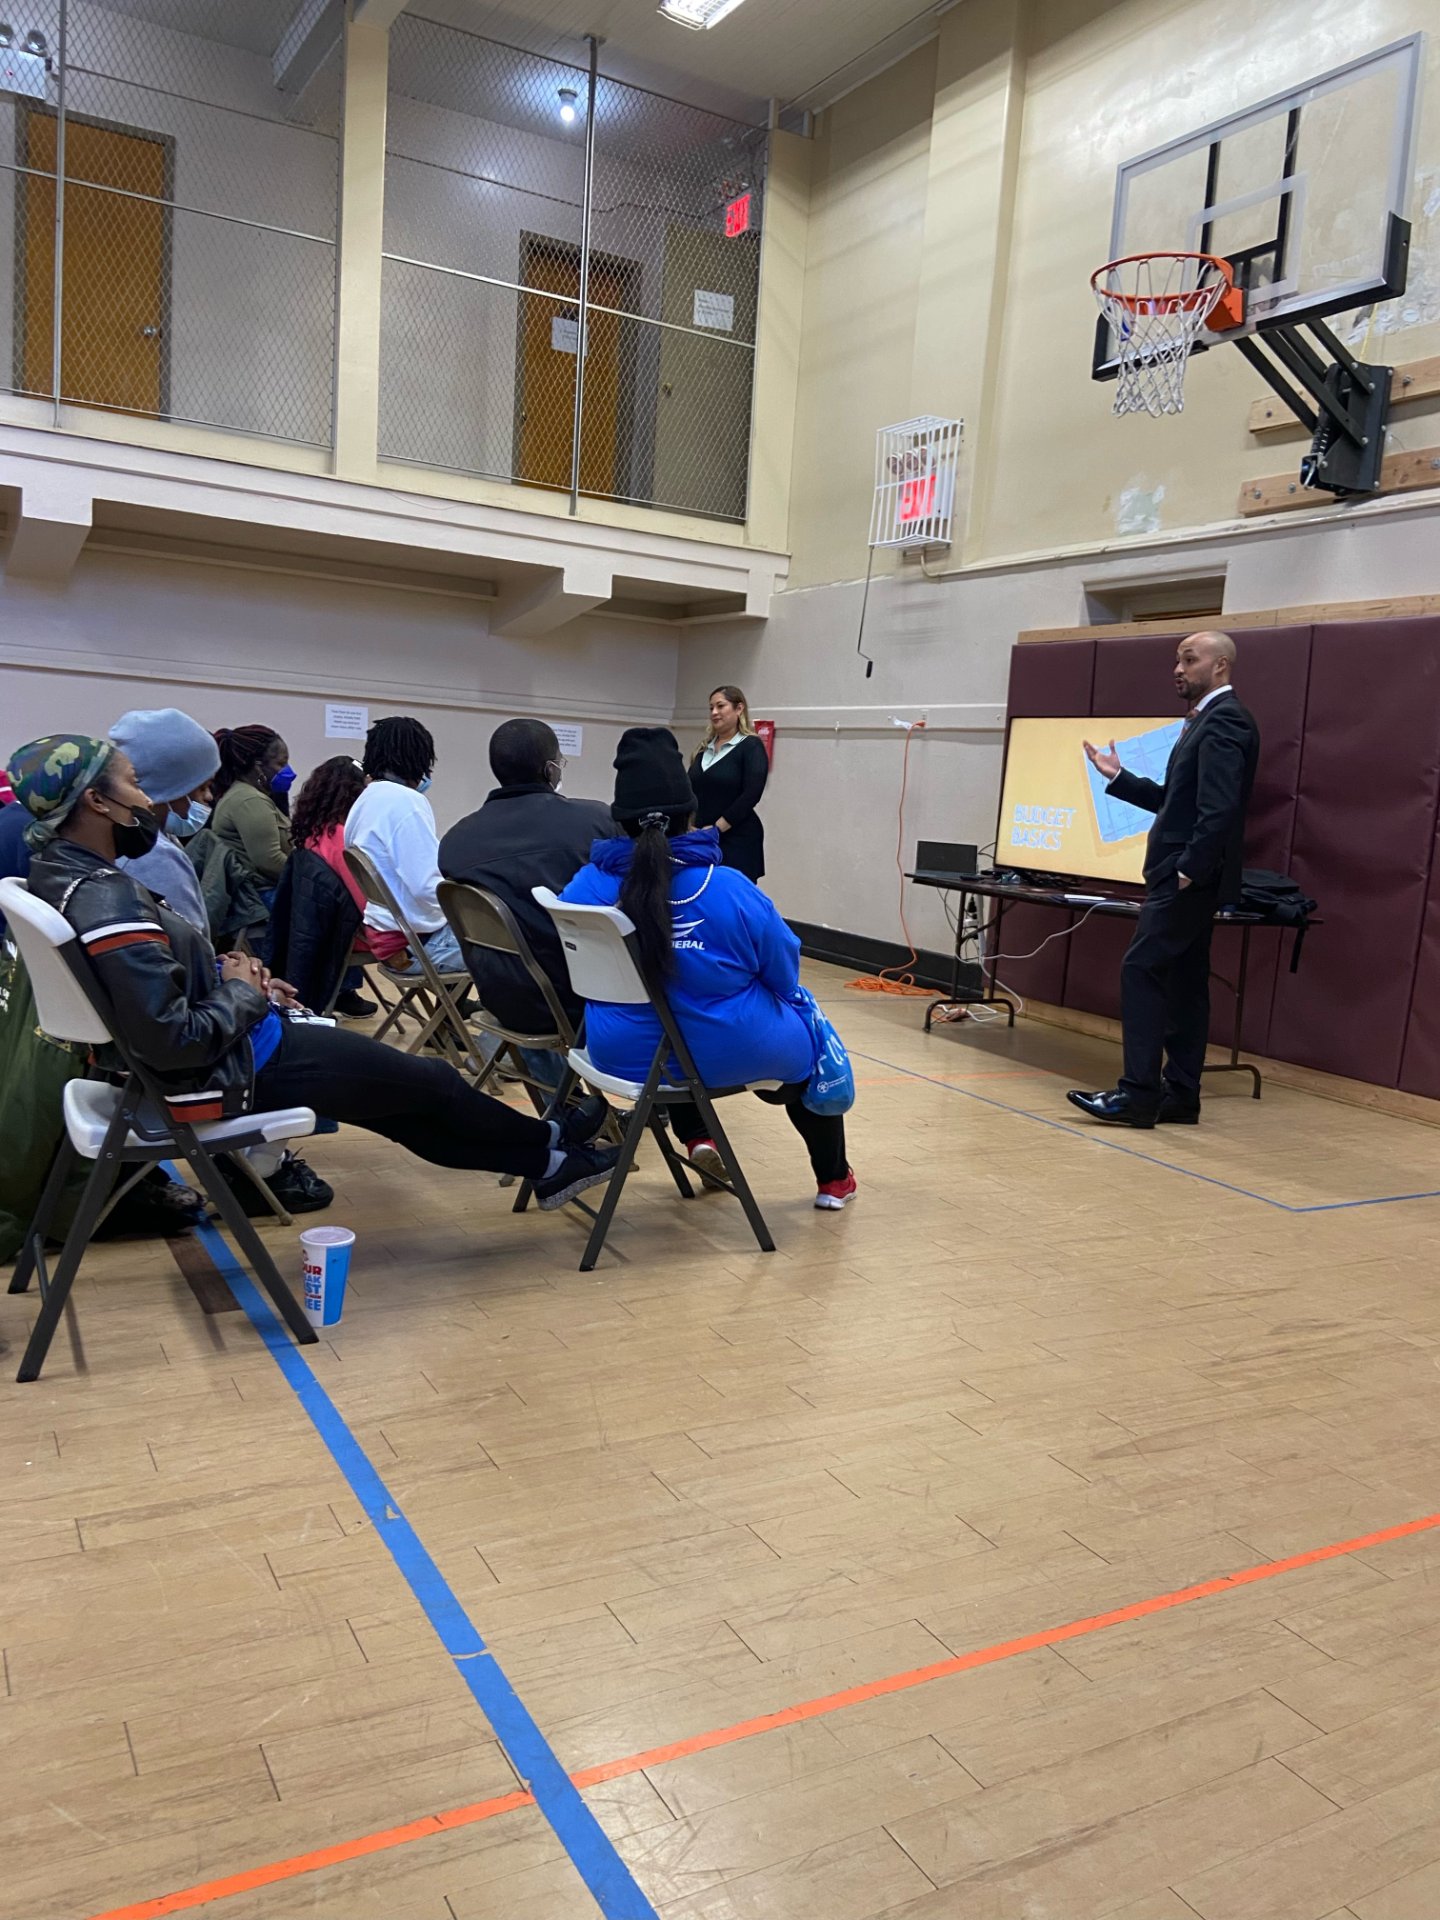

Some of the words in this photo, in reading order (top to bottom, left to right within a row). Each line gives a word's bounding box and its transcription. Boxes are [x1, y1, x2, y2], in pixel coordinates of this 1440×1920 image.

[726, 194, 751, 237] EXIT
[1014, 804, 1077, 828] BUDGET
[1011, 826, 1061, 850] BASICS
